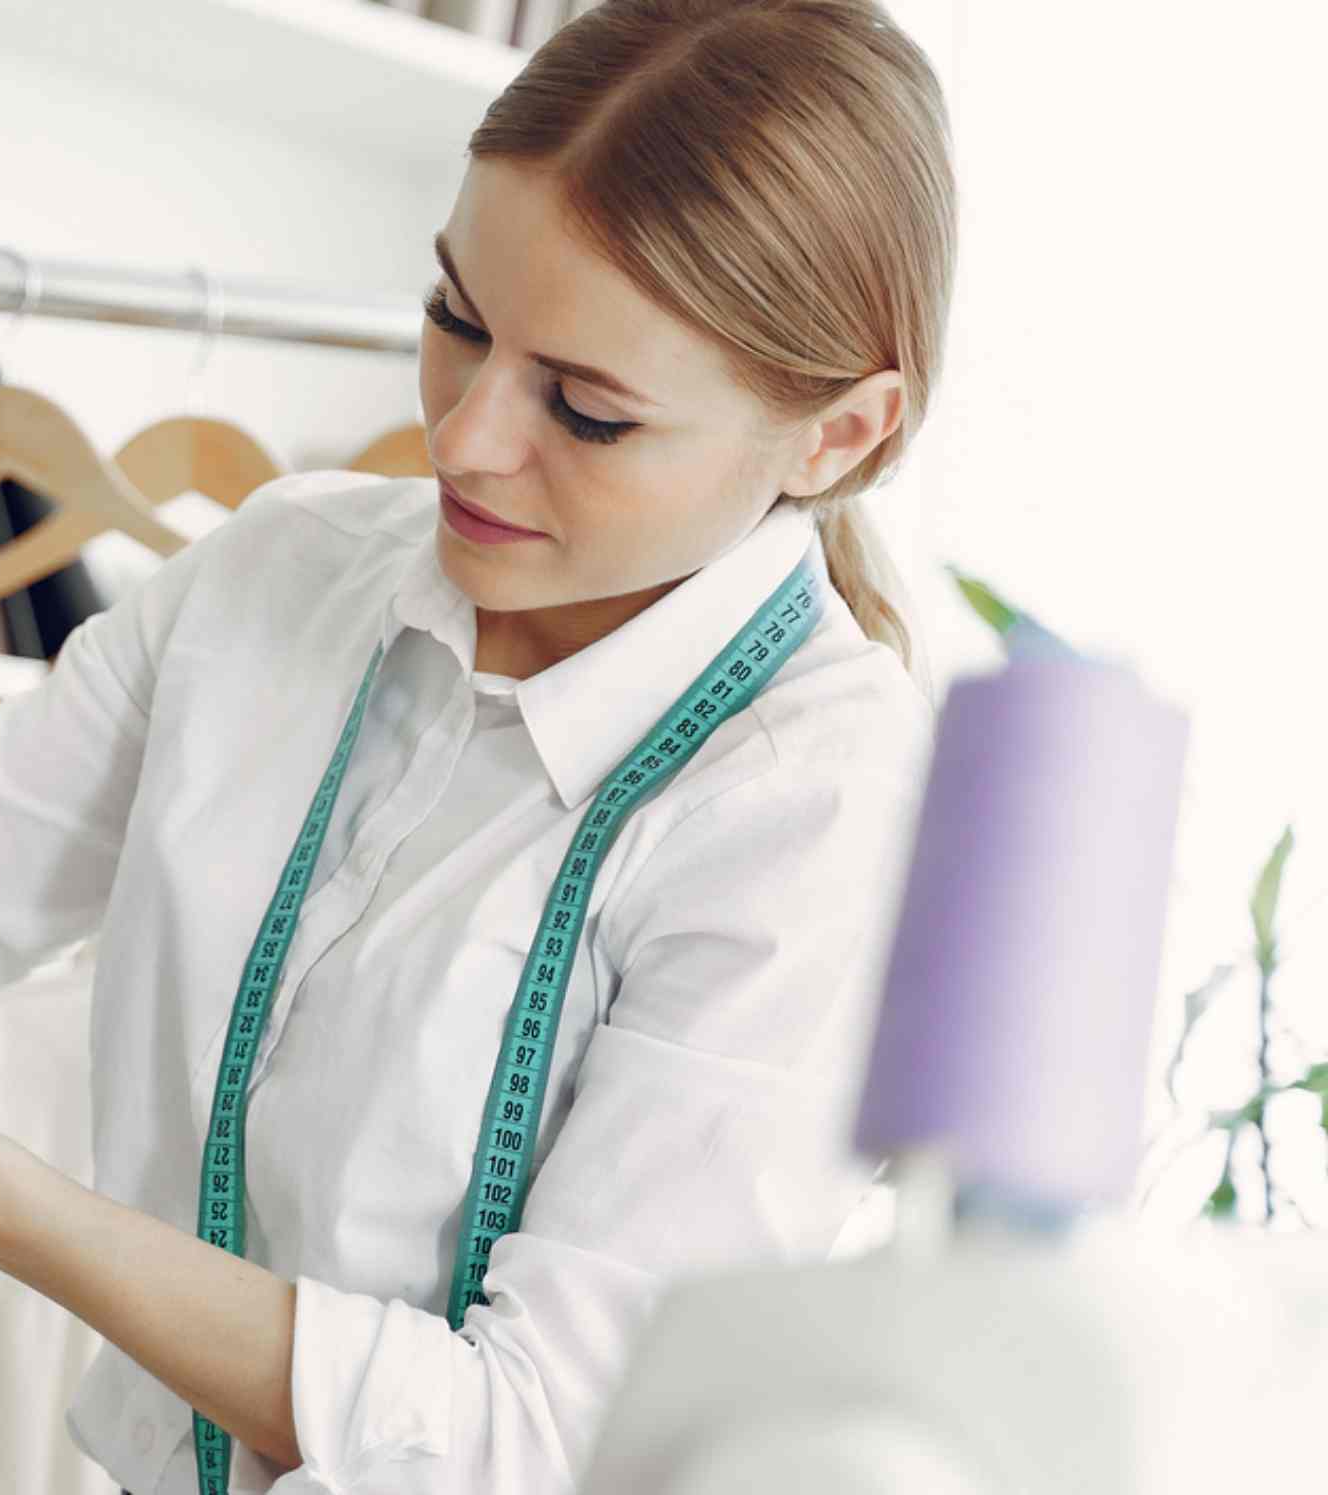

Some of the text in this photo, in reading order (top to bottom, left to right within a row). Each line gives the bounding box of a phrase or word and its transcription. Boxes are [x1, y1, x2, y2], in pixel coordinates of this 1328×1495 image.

[779, 604, 800, 624] 77
[764, 622, 785, 642] 78
[747, 640, 769, 661] 79
[728, 660, 752, 681] 80
[712, 680, 733, 700] 81
[694, 698, 717, 718] 82
[676, 719, 699, 738] 83
[658, 737, 681, 755] 84
[607, 788, 627, 802] 87
[561, 884, 577, 903] 91
[552, 910, 571, 930] 92
[544, 937, 564, 957] 93
[536, 964, 556, 984] 94
[529, 991, 548, 1011] 95
[522, 1018, 541, 1039] 96
[516, 1047, 536, 1066] 97
[509, 1074, 530, 1094] 98
[503, 1101, 524, 1121] 99
[494, 1129, 522, 1150] 100
[213, 1147, 230, 1165] 27
[488, 1156, 516, 1177] 101
[213, 1175, 230, 1193] 26
[484, 1183, 512, 1204] 102
[211, 1201, 228, 1220] 25
[478, 1210, 507, 1230] 103
[210, 1230, 228, 1248] 24
[473, 1236, 491, 1255] 10
[469, 1263, 487, 1282] 10
